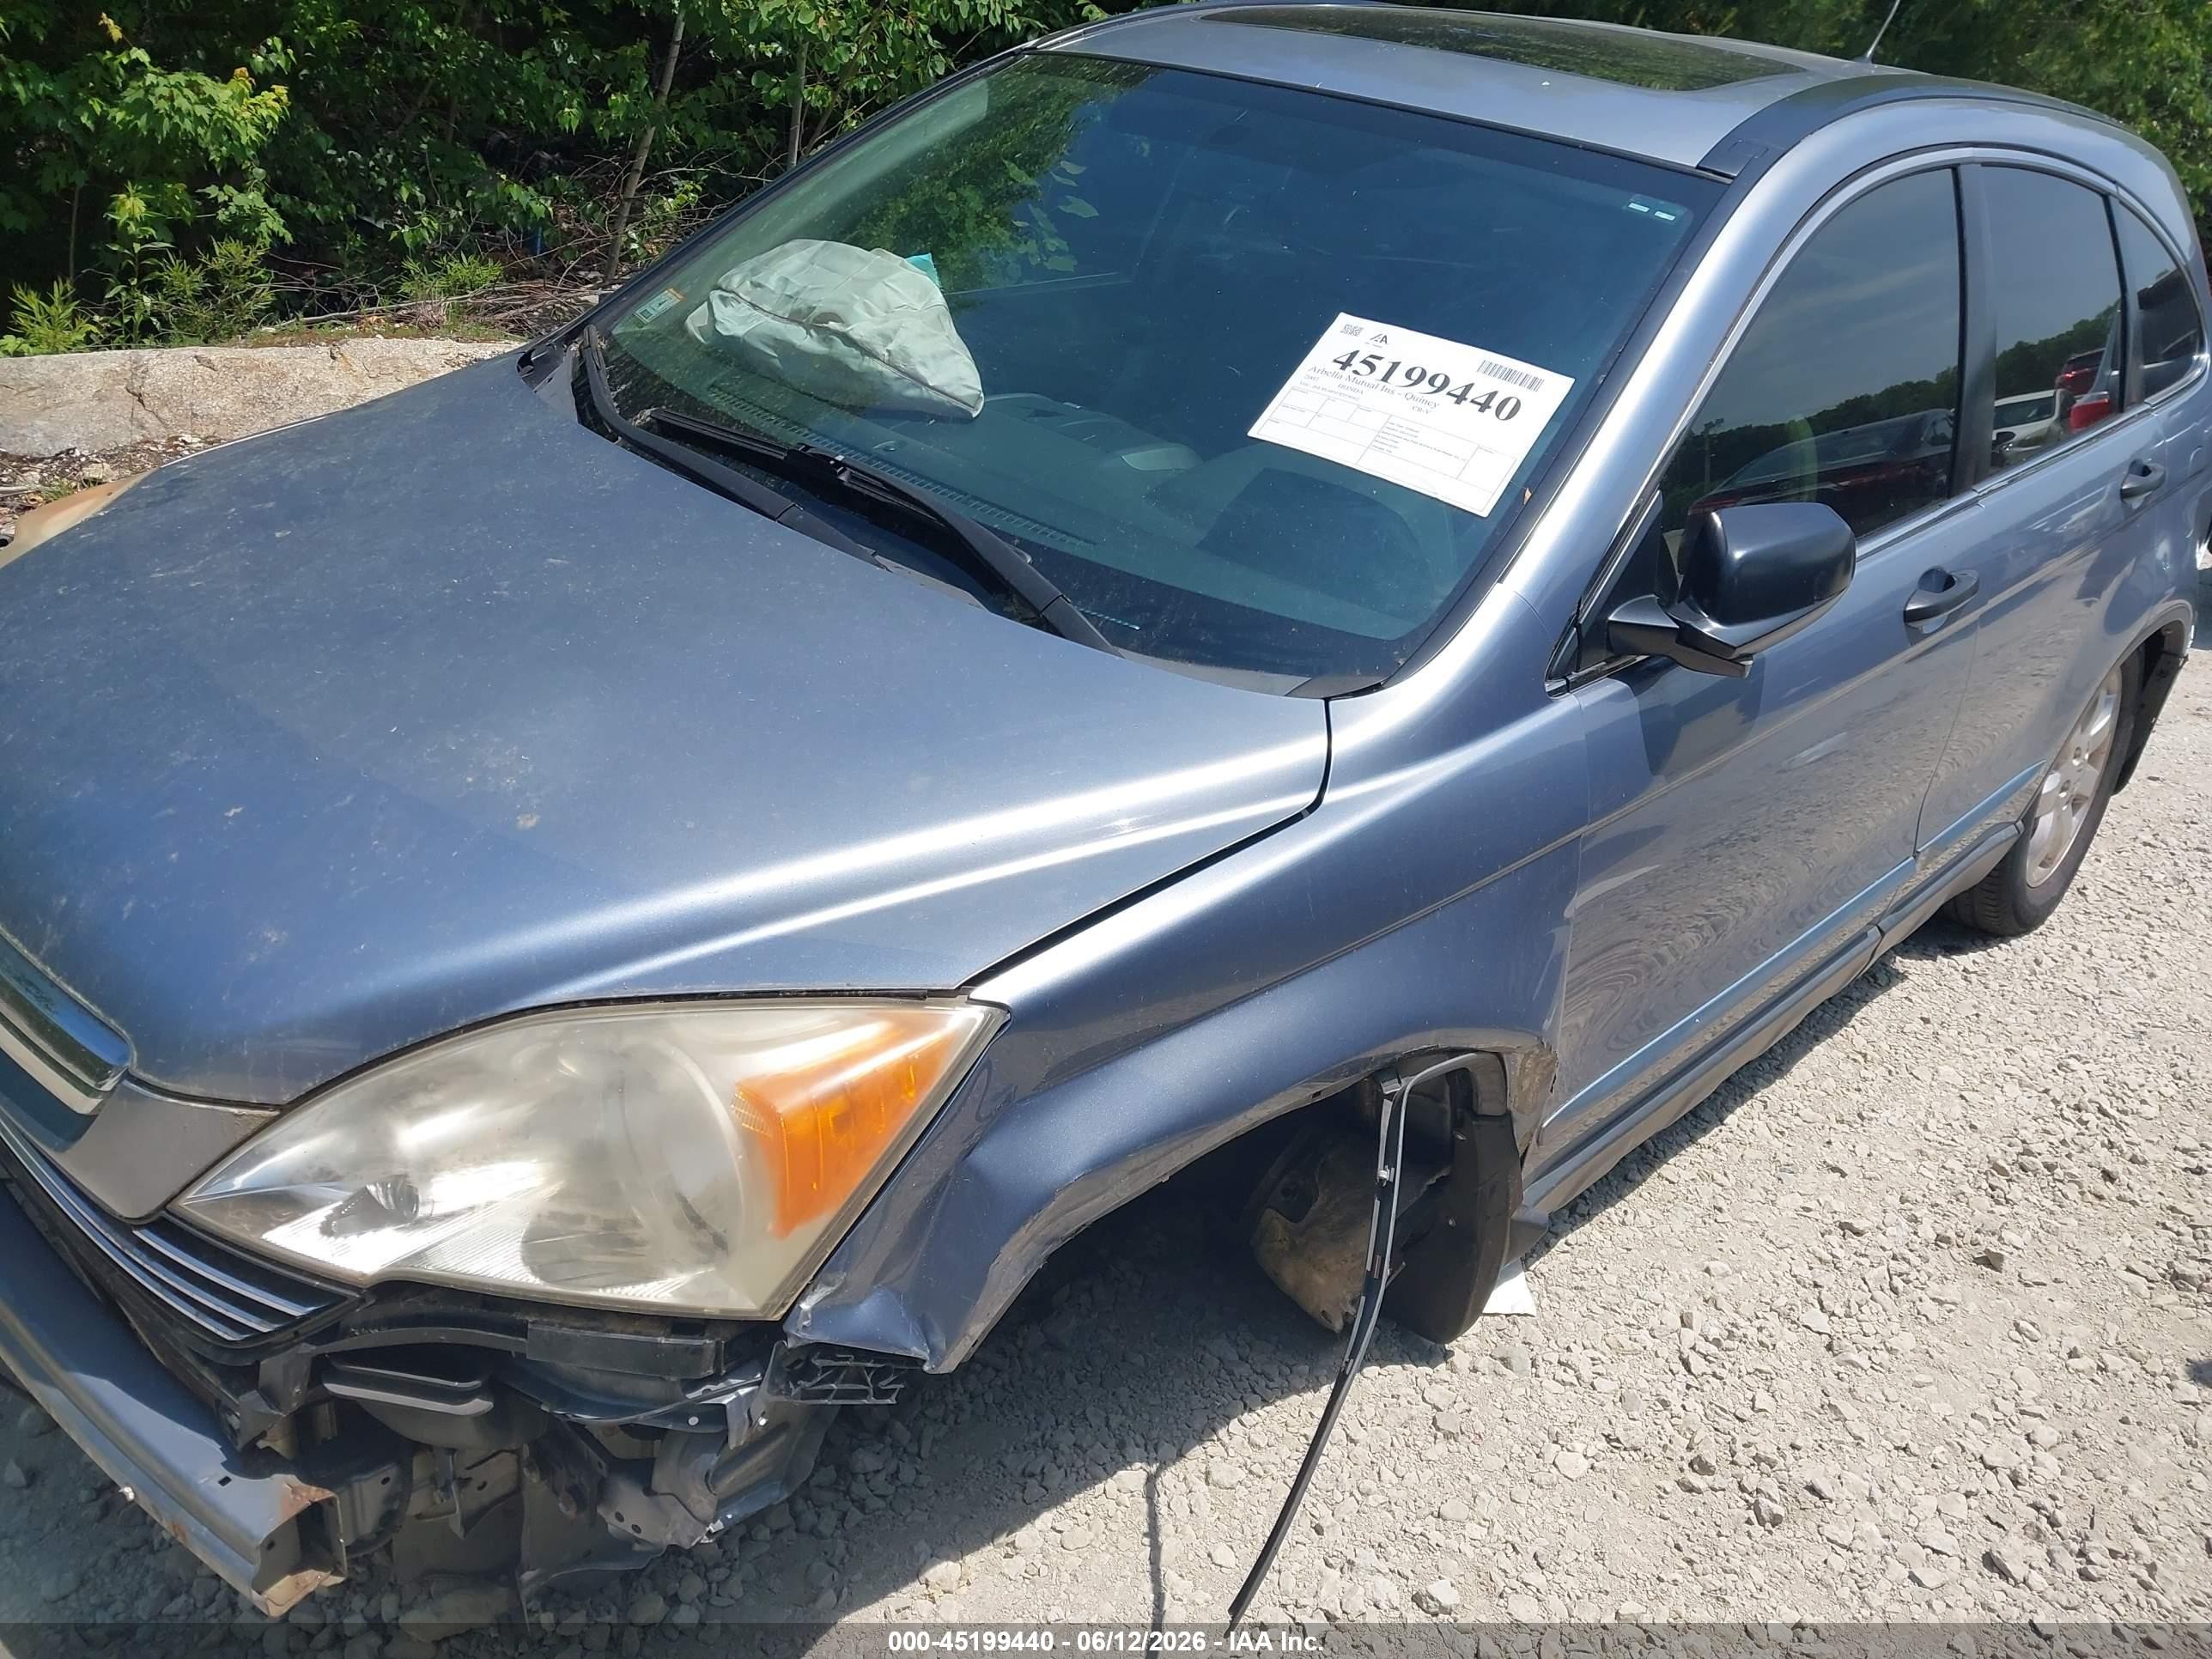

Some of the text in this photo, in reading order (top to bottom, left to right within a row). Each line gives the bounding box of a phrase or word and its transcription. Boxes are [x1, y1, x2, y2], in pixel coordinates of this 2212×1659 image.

[1308, 365, 1343, 380] Arbella
[1345, 374, 1379, 392] Mutual
[1379, 382, 1396, 396] Ins
[1404, 391, 1440, 409] Quincy
[1333, 349, 1522, 422] 45199440
[1338, 383, 1364, 395] HONDA
